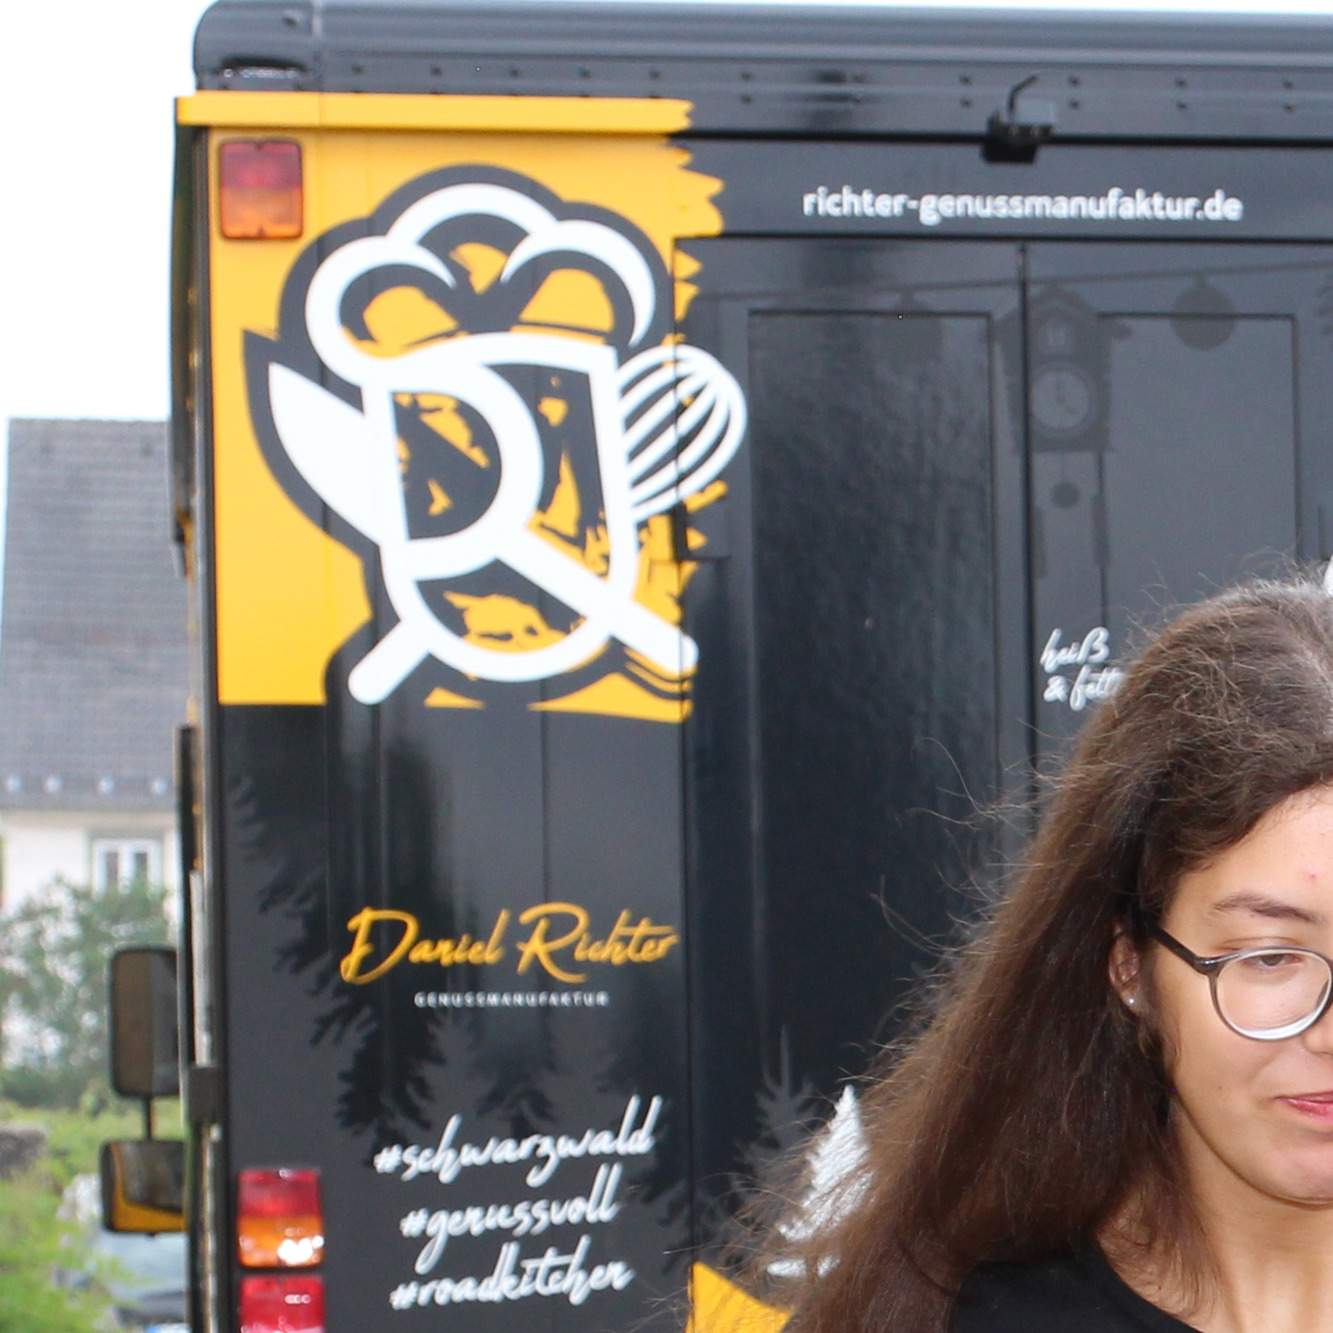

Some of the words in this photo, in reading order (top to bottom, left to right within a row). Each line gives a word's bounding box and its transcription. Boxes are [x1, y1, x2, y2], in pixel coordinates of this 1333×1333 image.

[802, 184, 1244, 226] richter-genussmanufaktur.de
[339, 906, 510, 984] Daniel
[516, 901, 681, 983] Richter
[413, 991, 610, 1008] GENUSSMANUFAKTUR
[373, 1094, 663, 1188] #schwarzwald
[399, 1161, 624, 1275] #genussvoll
[389, 1233, 637, 1310] #roadkitchen
